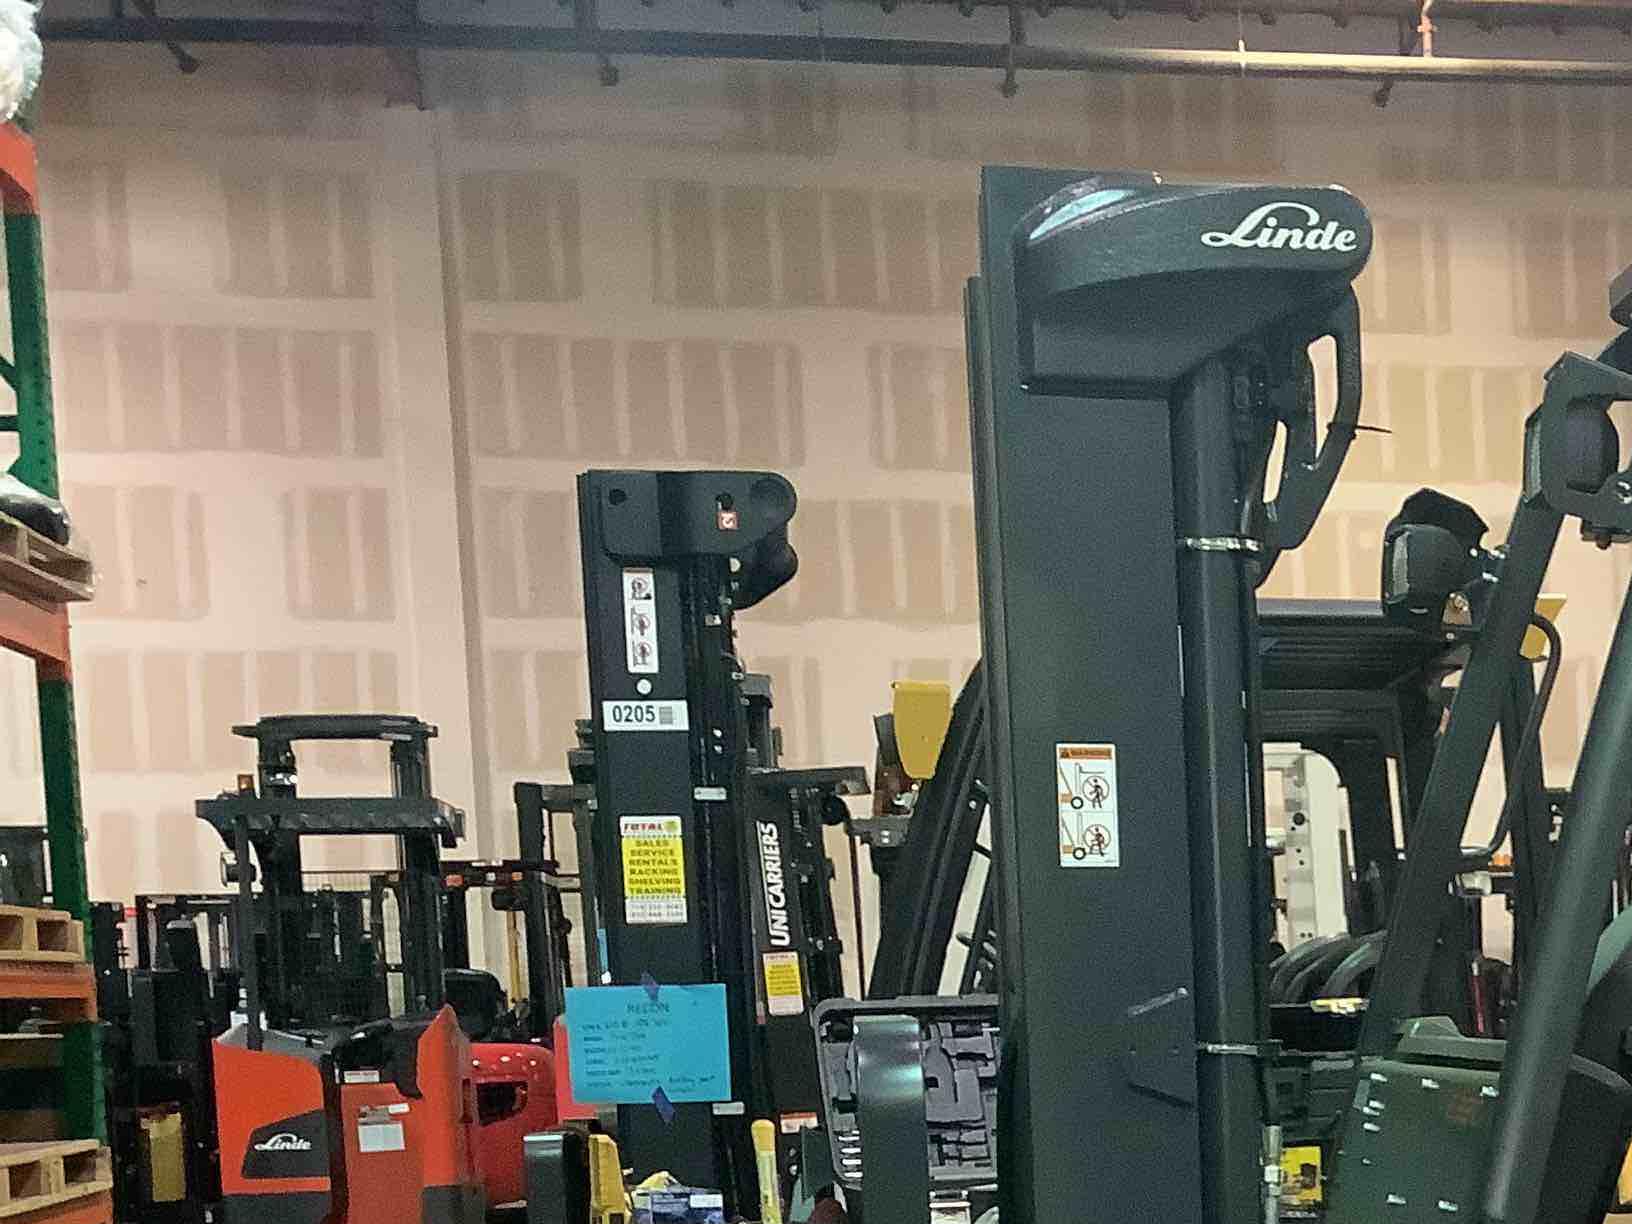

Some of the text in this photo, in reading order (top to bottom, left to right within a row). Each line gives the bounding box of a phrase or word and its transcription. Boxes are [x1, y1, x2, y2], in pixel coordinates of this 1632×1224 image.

[1201, 201, 1358, 251] Linde
[612, 704, 656, 723] 0205
[630, 848, 675, 857] SERVICE
[635, 839, 670, 848] SALES
[628, 858, 678, 867] RENTALS
[757, 821, 790, 947] UNICARRIERS
[254, 1132, 312, 1151] Linde
